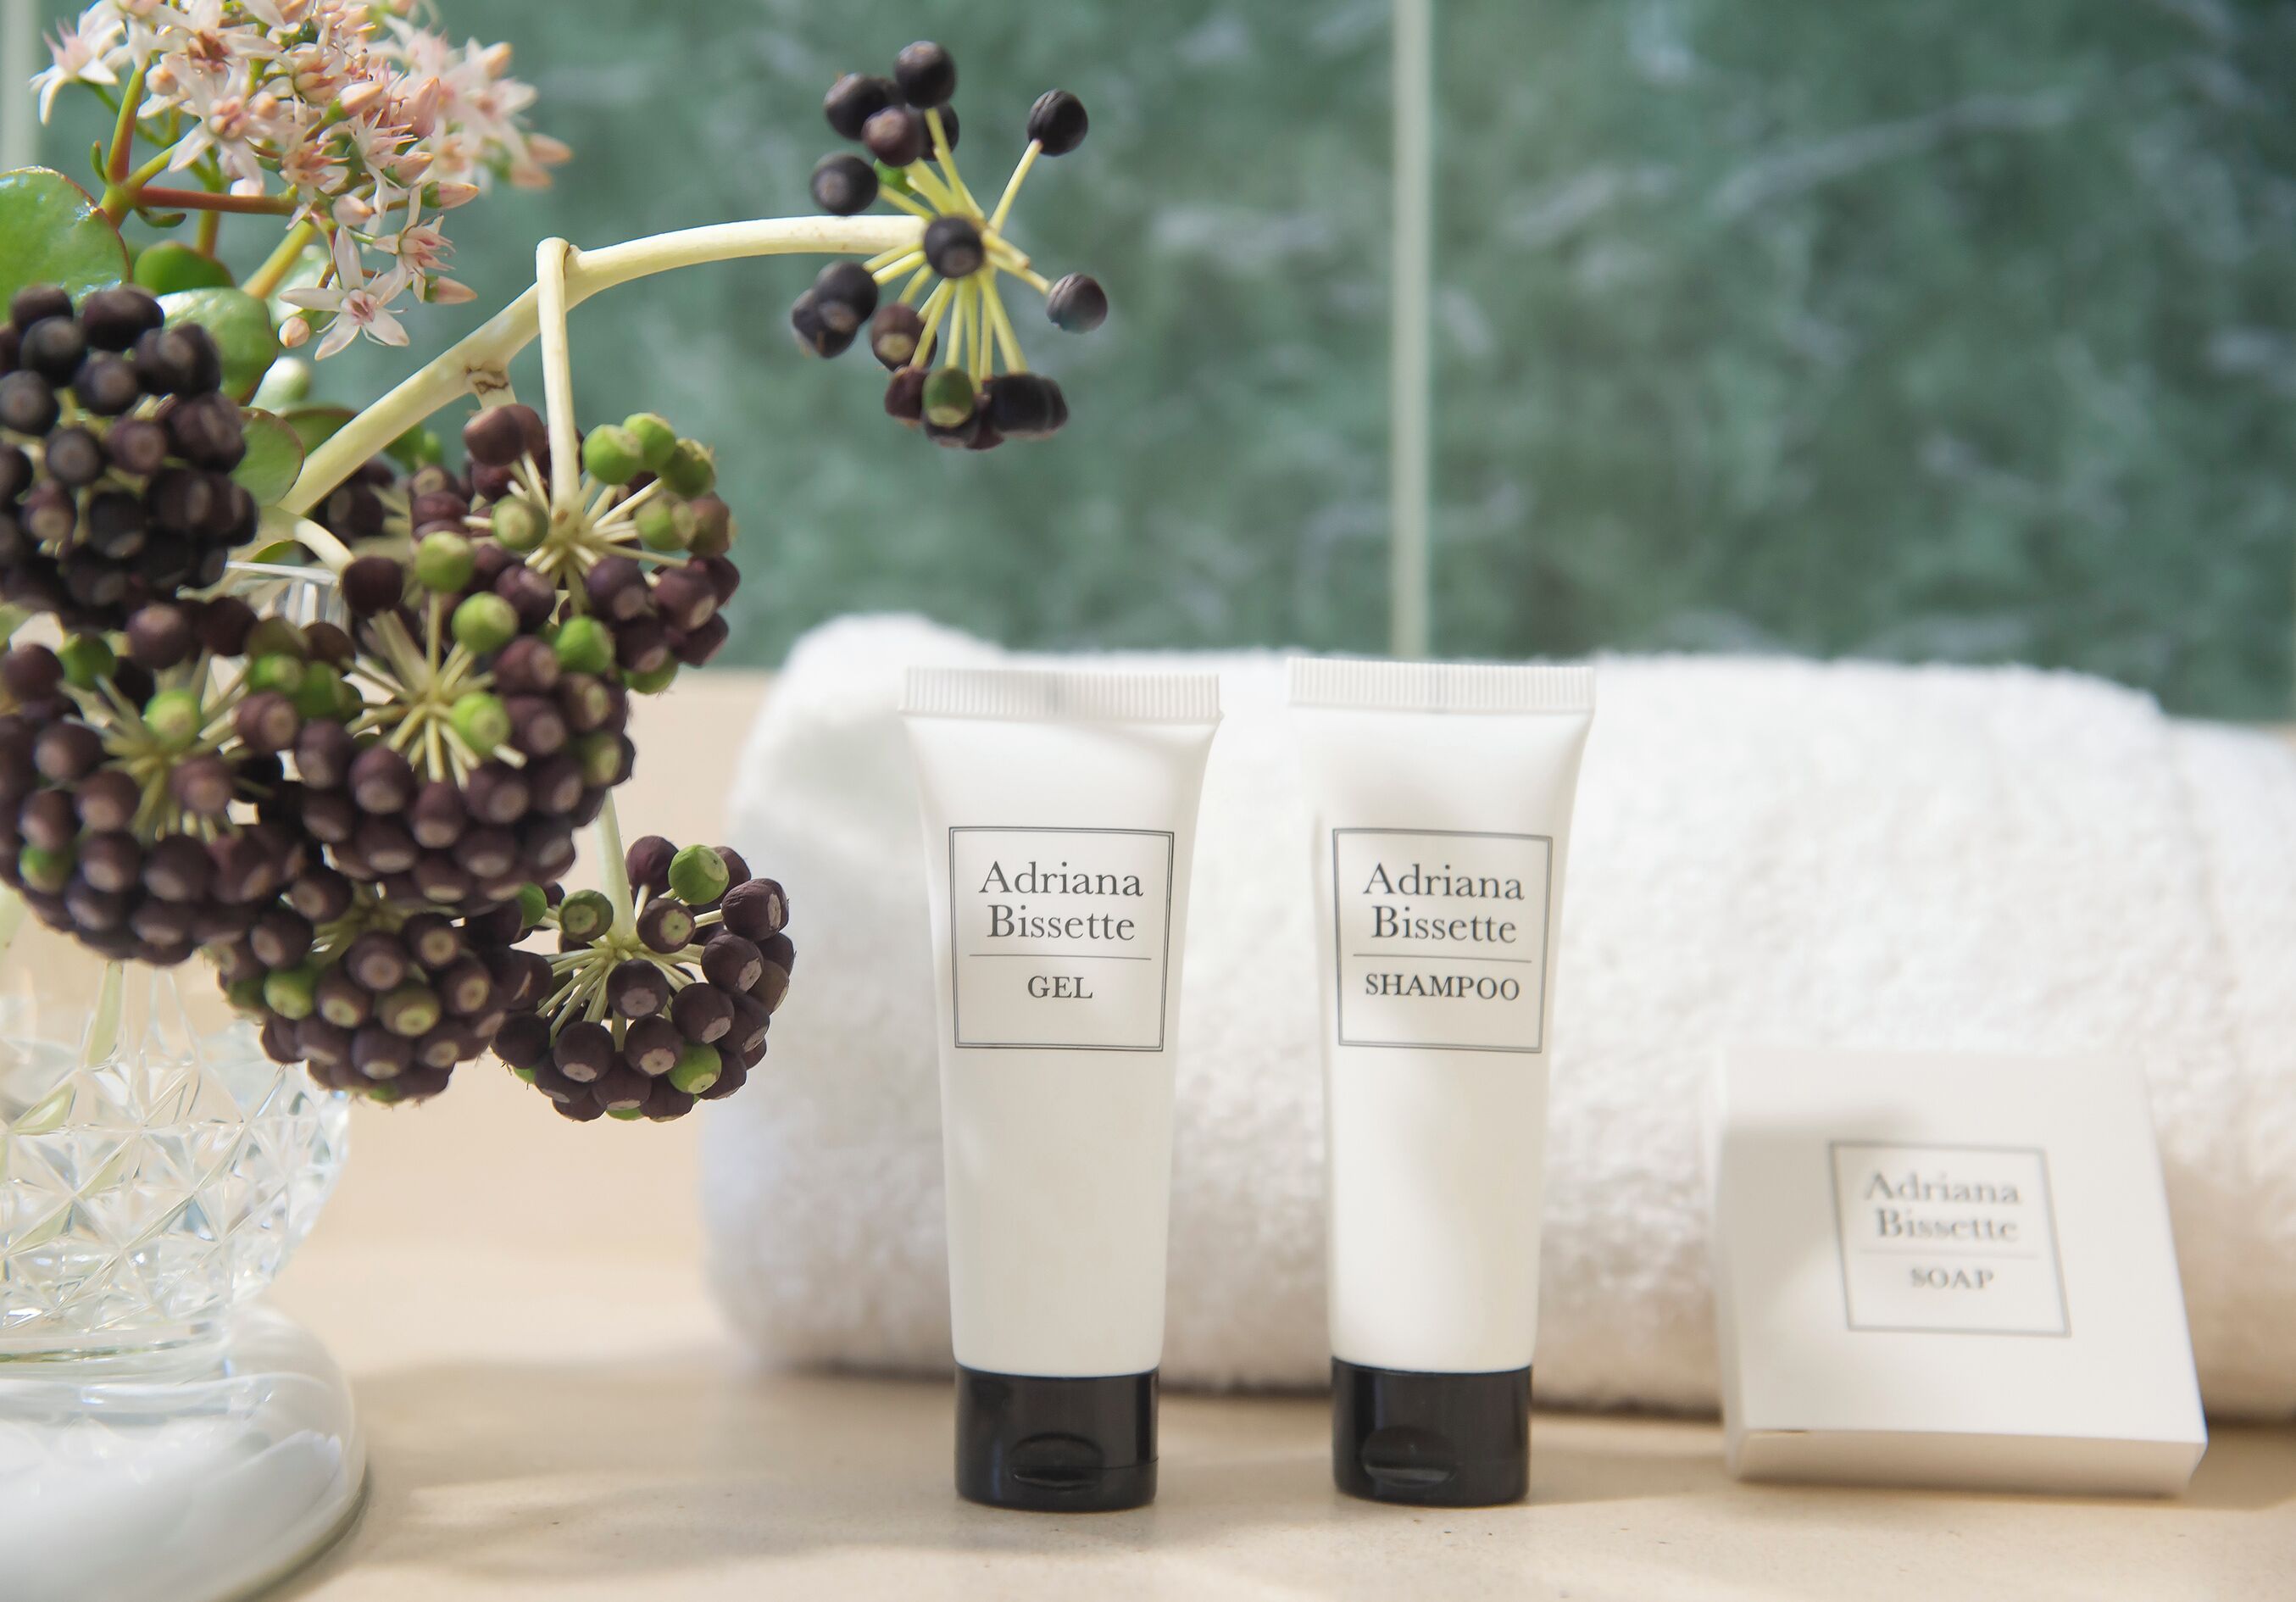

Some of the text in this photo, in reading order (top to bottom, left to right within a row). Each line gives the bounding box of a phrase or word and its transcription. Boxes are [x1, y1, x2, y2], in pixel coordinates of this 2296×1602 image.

[978, 860, 1144, 897] Adriana
[1363, 862, 1525, 900] Adriana
[987, 904, 1135, 941] Bissette
[1371, 905, 1517, 943] Bissette
[1027, 976, 1093, 999] GEL
[1365, 973, 1520, 1001] SHAMPOO
[1865, 1171, 2021, 1204] Adriana
[1876, 1208, 2019, 1242] Bissette
[1910, 1268, 1994, 1289] SOAP
